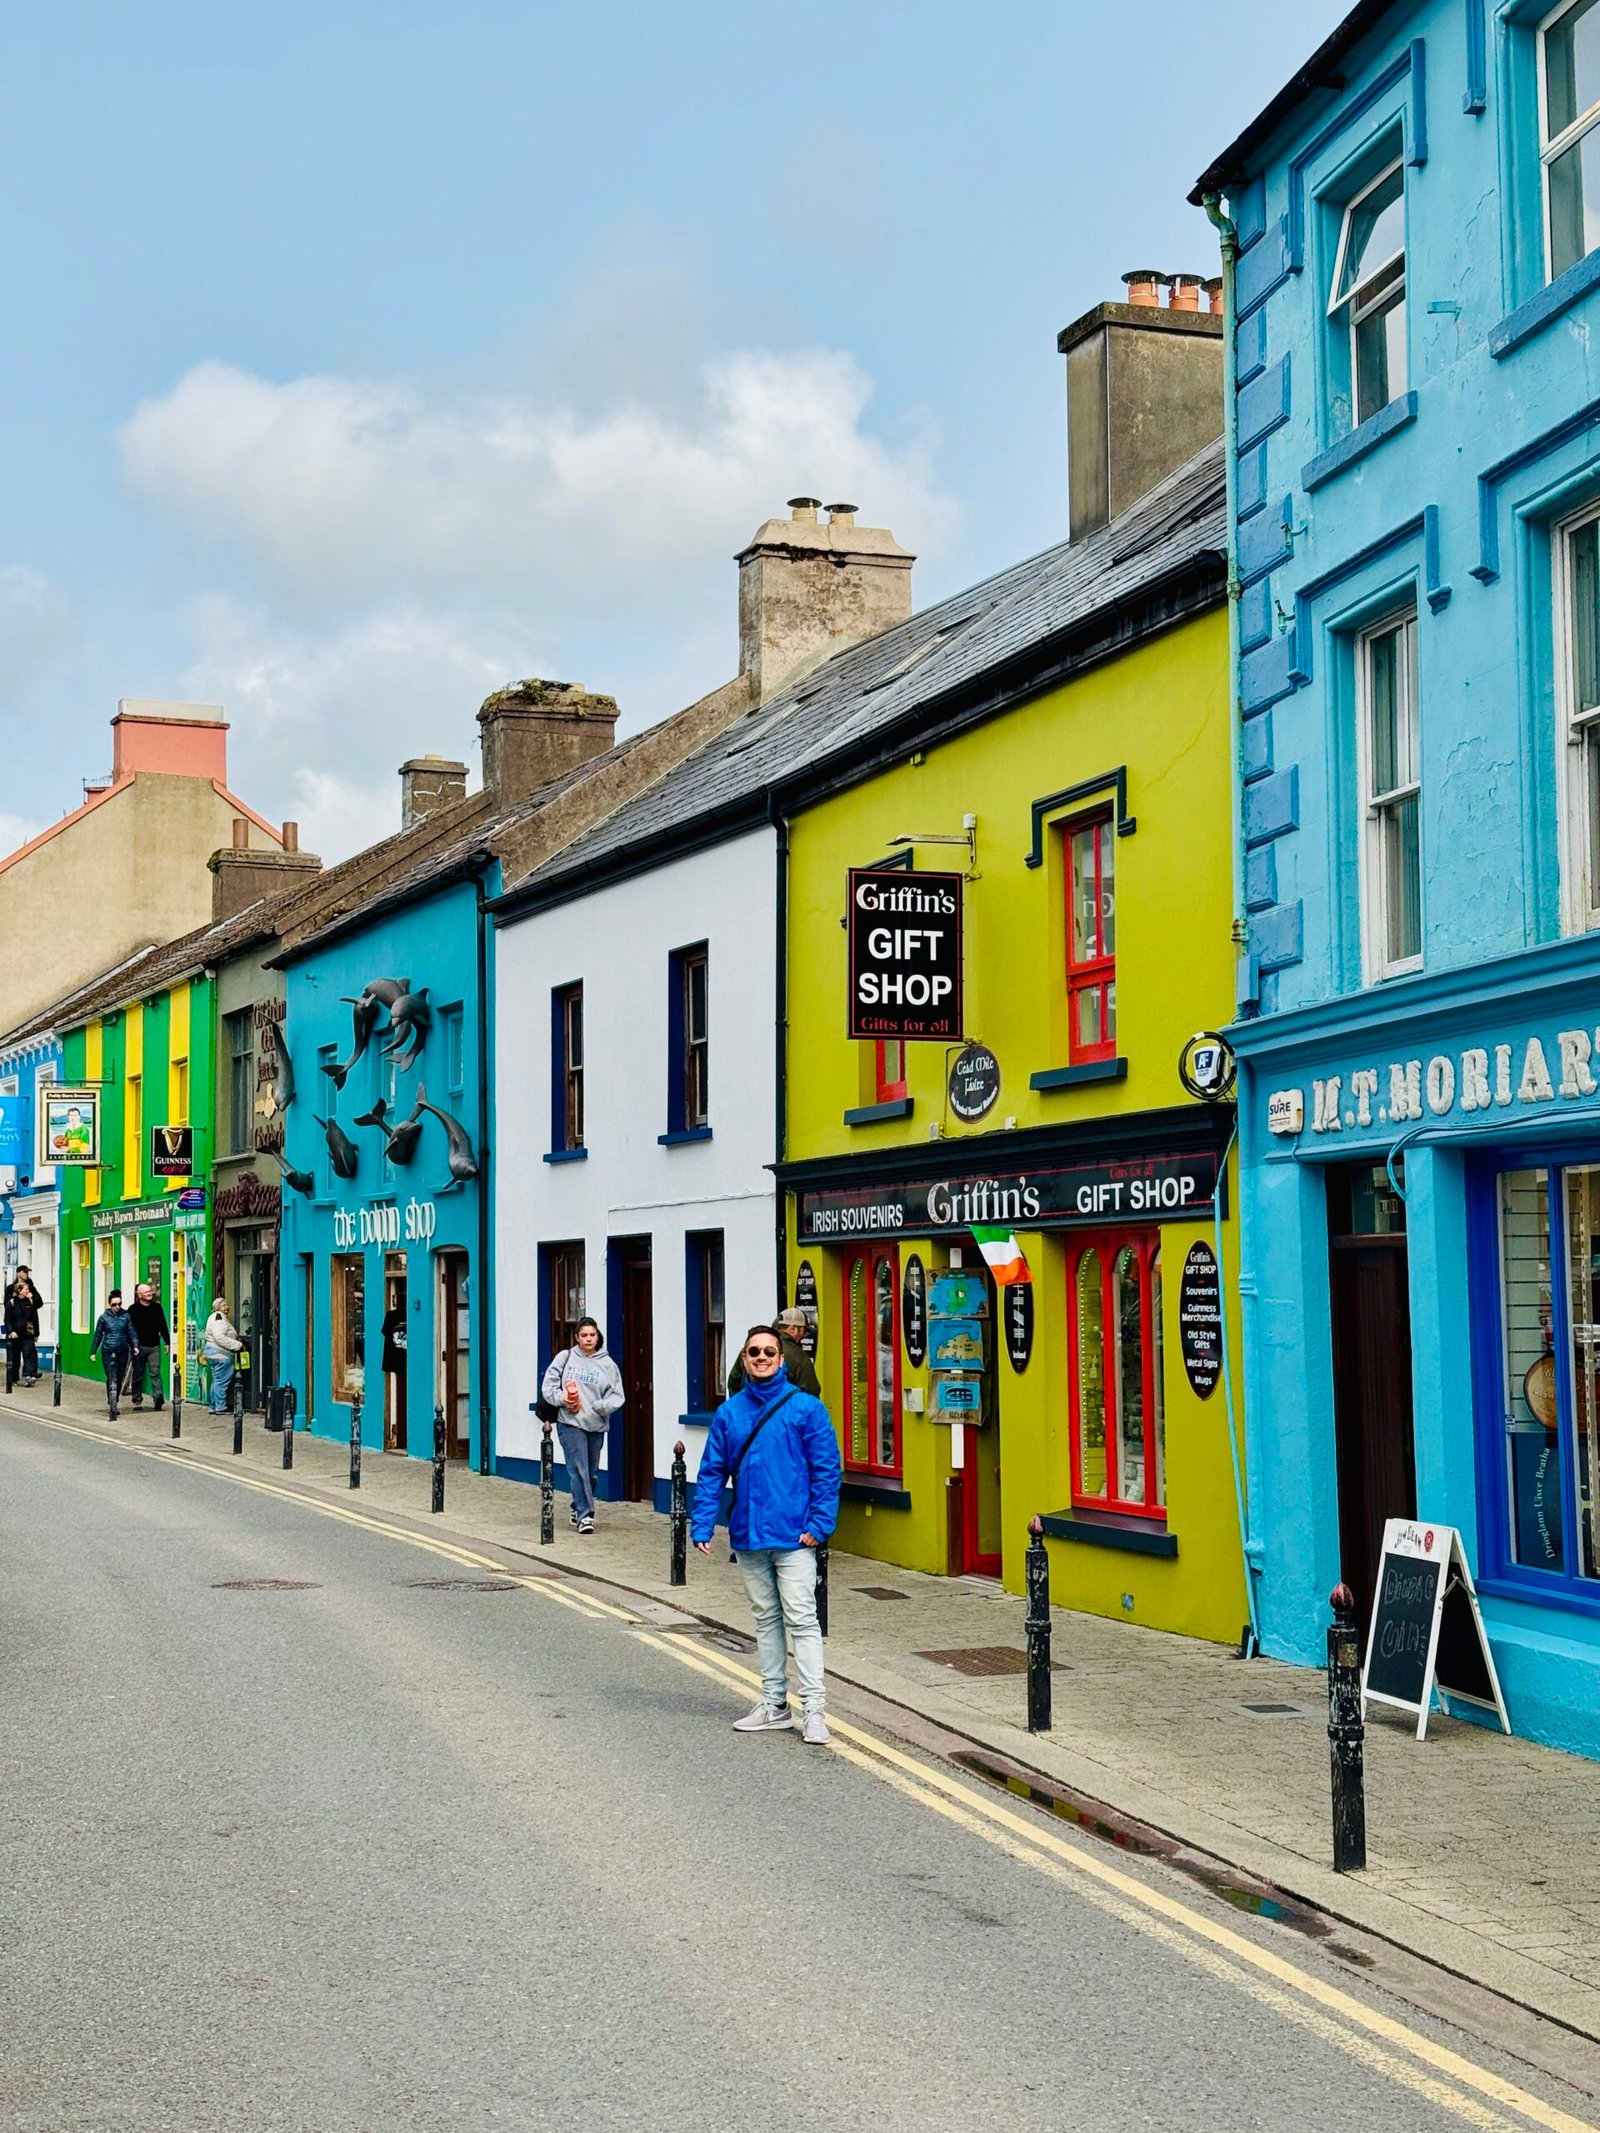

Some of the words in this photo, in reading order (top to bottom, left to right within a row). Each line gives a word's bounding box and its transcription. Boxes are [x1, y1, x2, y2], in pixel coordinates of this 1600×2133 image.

[856, 883, 956, 914] Griffin's
[868, 928, 944, 961] GIFT
[858, 972, 952, 1006] SHOP
[860, 1016, 898, 1031] Gifts
[903, 1018, 925, 1032] for
[930, 1019, 949, 1033] all
[1269, 1101, 1291, 1116] SURE
[155, 1156, 192, 1165] GUINNESS
[926, 1176, 1041, 1225] Griffin's
[1076, 1182, 1124, 1214] GIFT
[1130, 1176, 1195, 1210] SHOP
[93, 1212, 114, 1230] Paddy
[113, 1208, 133, 1225] Bawn
[134, 1202, 170, 1223] Brosnan's
[812, 1209, 839, 1233] IRISH
[840, 1204, 903, 1232] SOUVENIRS
[1185, 1265, 1199, 1275] GIFT
[1199, 1264, 1217, 1274] SHOP
[1185, 1286, 1217, 1296] Souvenirs
[1187, 1303, 1217, 1313] Guinness
[1187, 1330, 1198, 1340] Old
[1199, 1330, 1217, 1341] Style
[1193, 1340, 1210, 1349] Gifts
[1186, 1358, 1203, 1367] Metal
[1203, 1358, 1219, 1369] Signs
[1194, 1375, 1213, 1386] Mugs
[1535, 1447, 1551, 1480] Beatha
